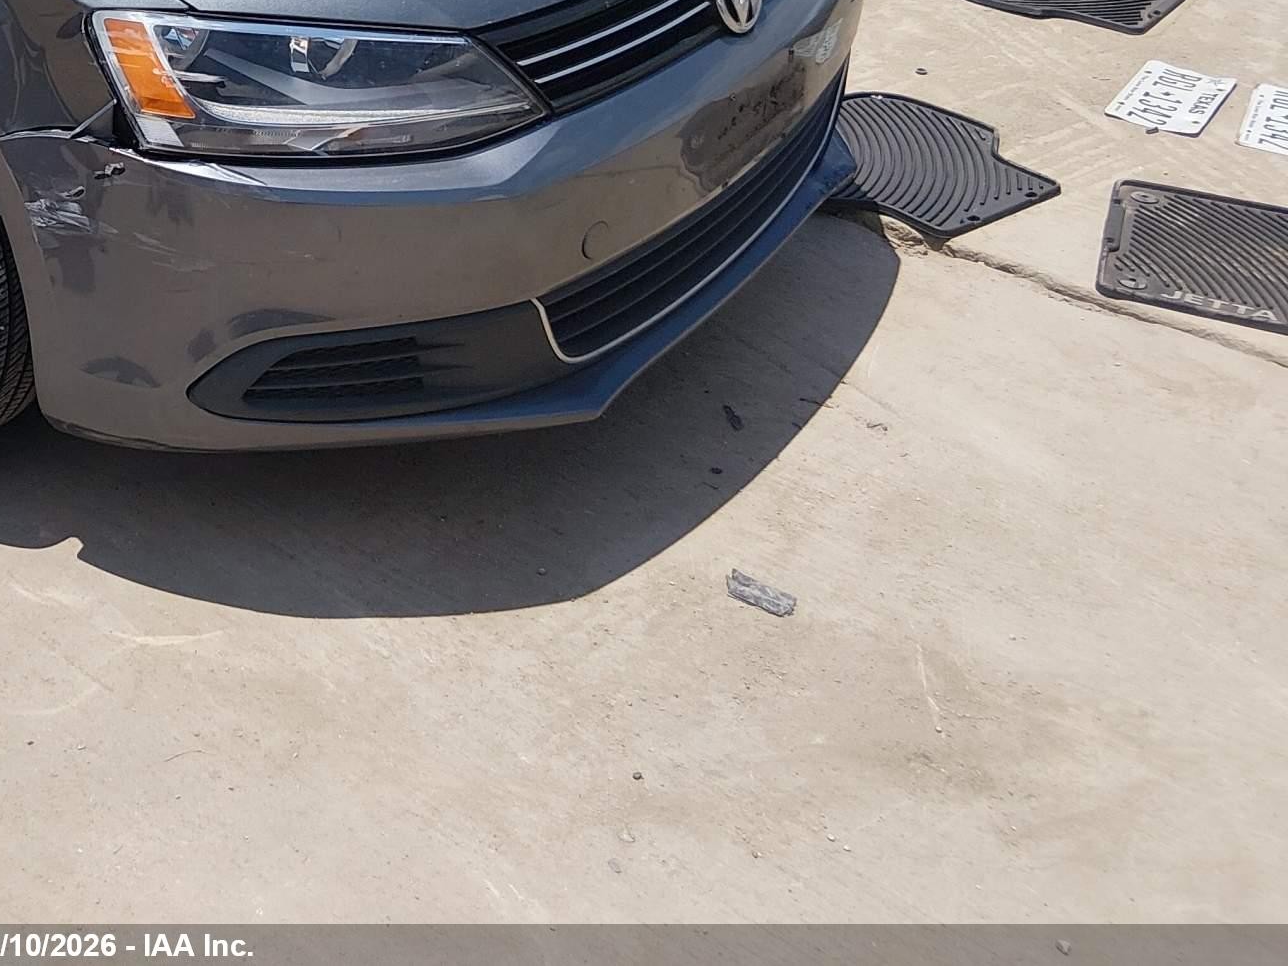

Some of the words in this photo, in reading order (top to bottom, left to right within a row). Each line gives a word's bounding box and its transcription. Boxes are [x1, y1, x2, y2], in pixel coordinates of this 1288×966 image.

[1126, 91, 1184, 126] 1342
[1188, 92, 1220, 115] TEXAS
[1160, 290, 1279, 322] JETTA
